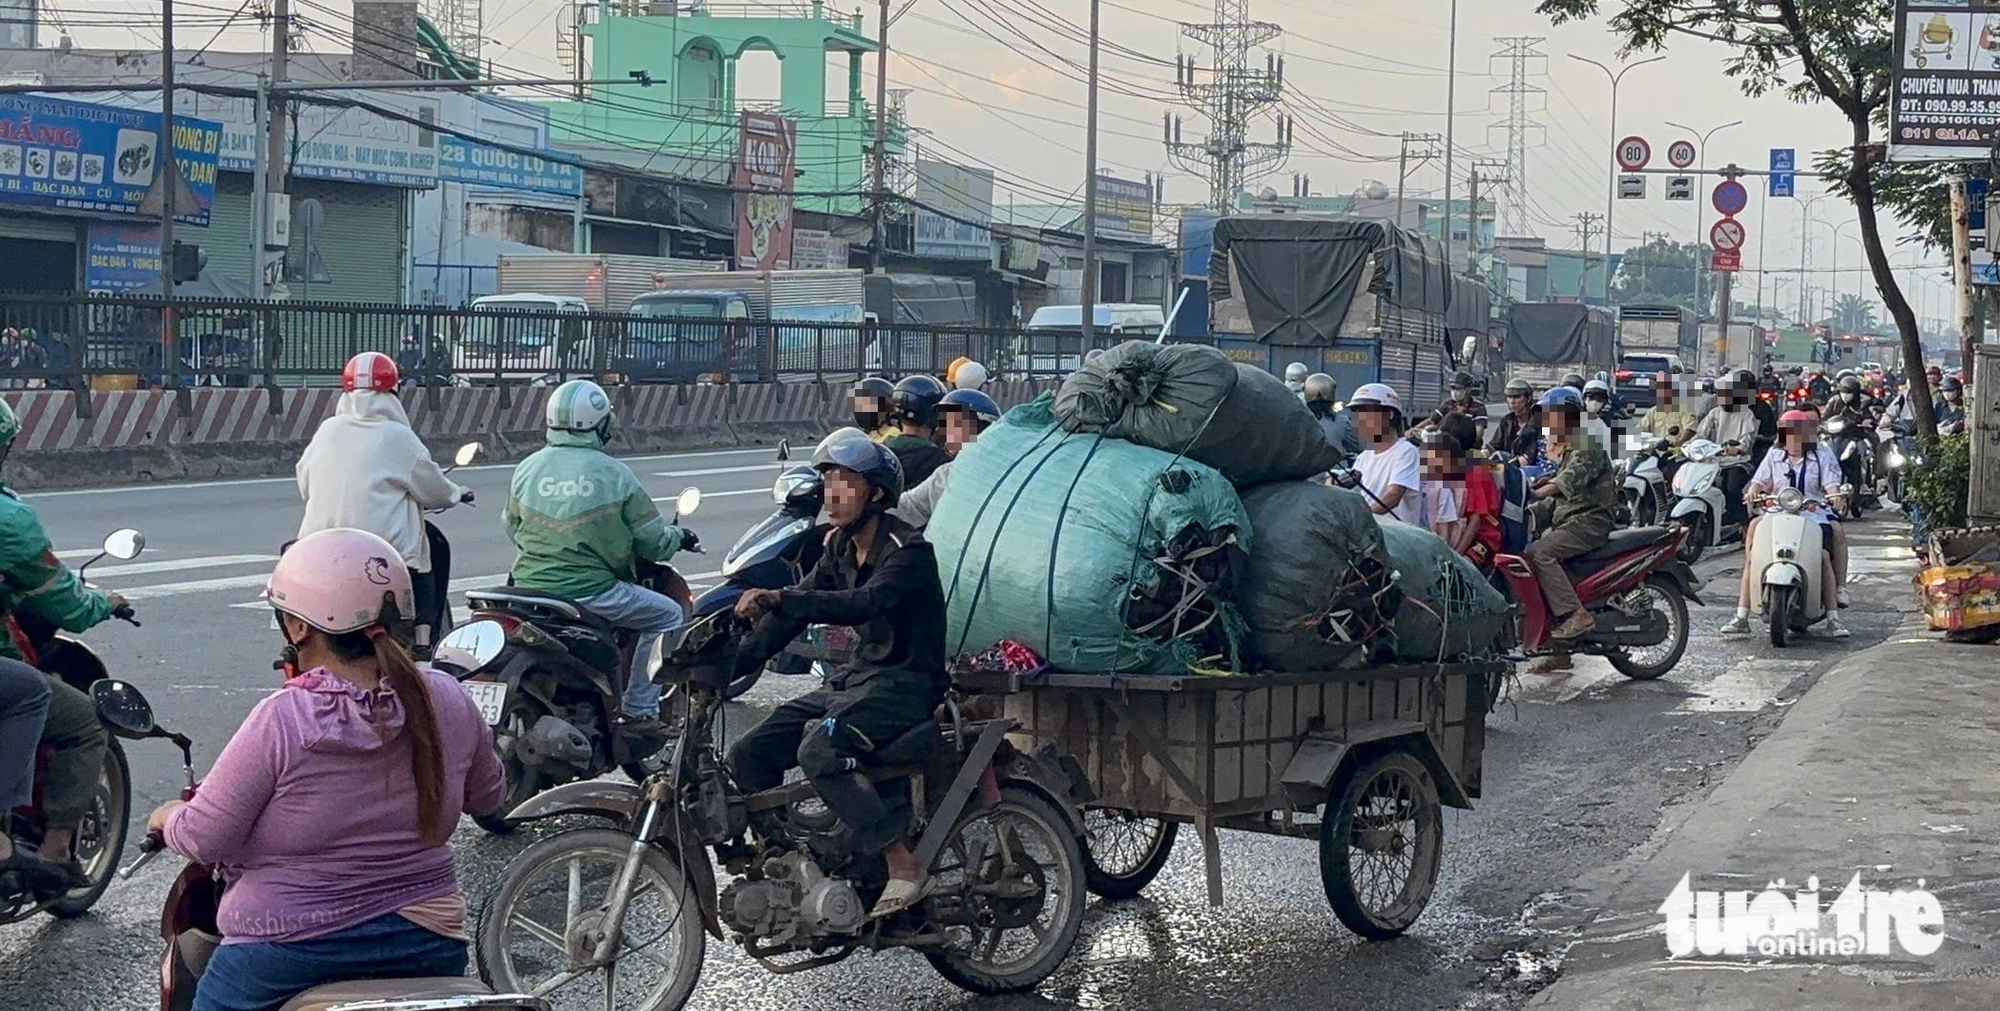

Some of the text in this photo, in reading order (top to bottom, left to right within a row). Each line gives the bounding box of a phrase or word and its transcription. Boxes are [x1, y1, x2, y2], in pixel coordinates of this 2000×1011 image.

[1946, 78, 1969, 95] MUA
[1900, 98, 1921, 111] ĐT:
[1901, 127, 1931, 139] 611
[1935, 128, 1980, 140] QL1A
[204, 131, 218, 154] BI
[439, 144, 466, 163] 28
[1626, 146, 1641, 161] 80
[1676, 149, 1688, 160] 60
[917, 215, 946, 240] MOTOR
[538, 475, 594, 497] Grab
